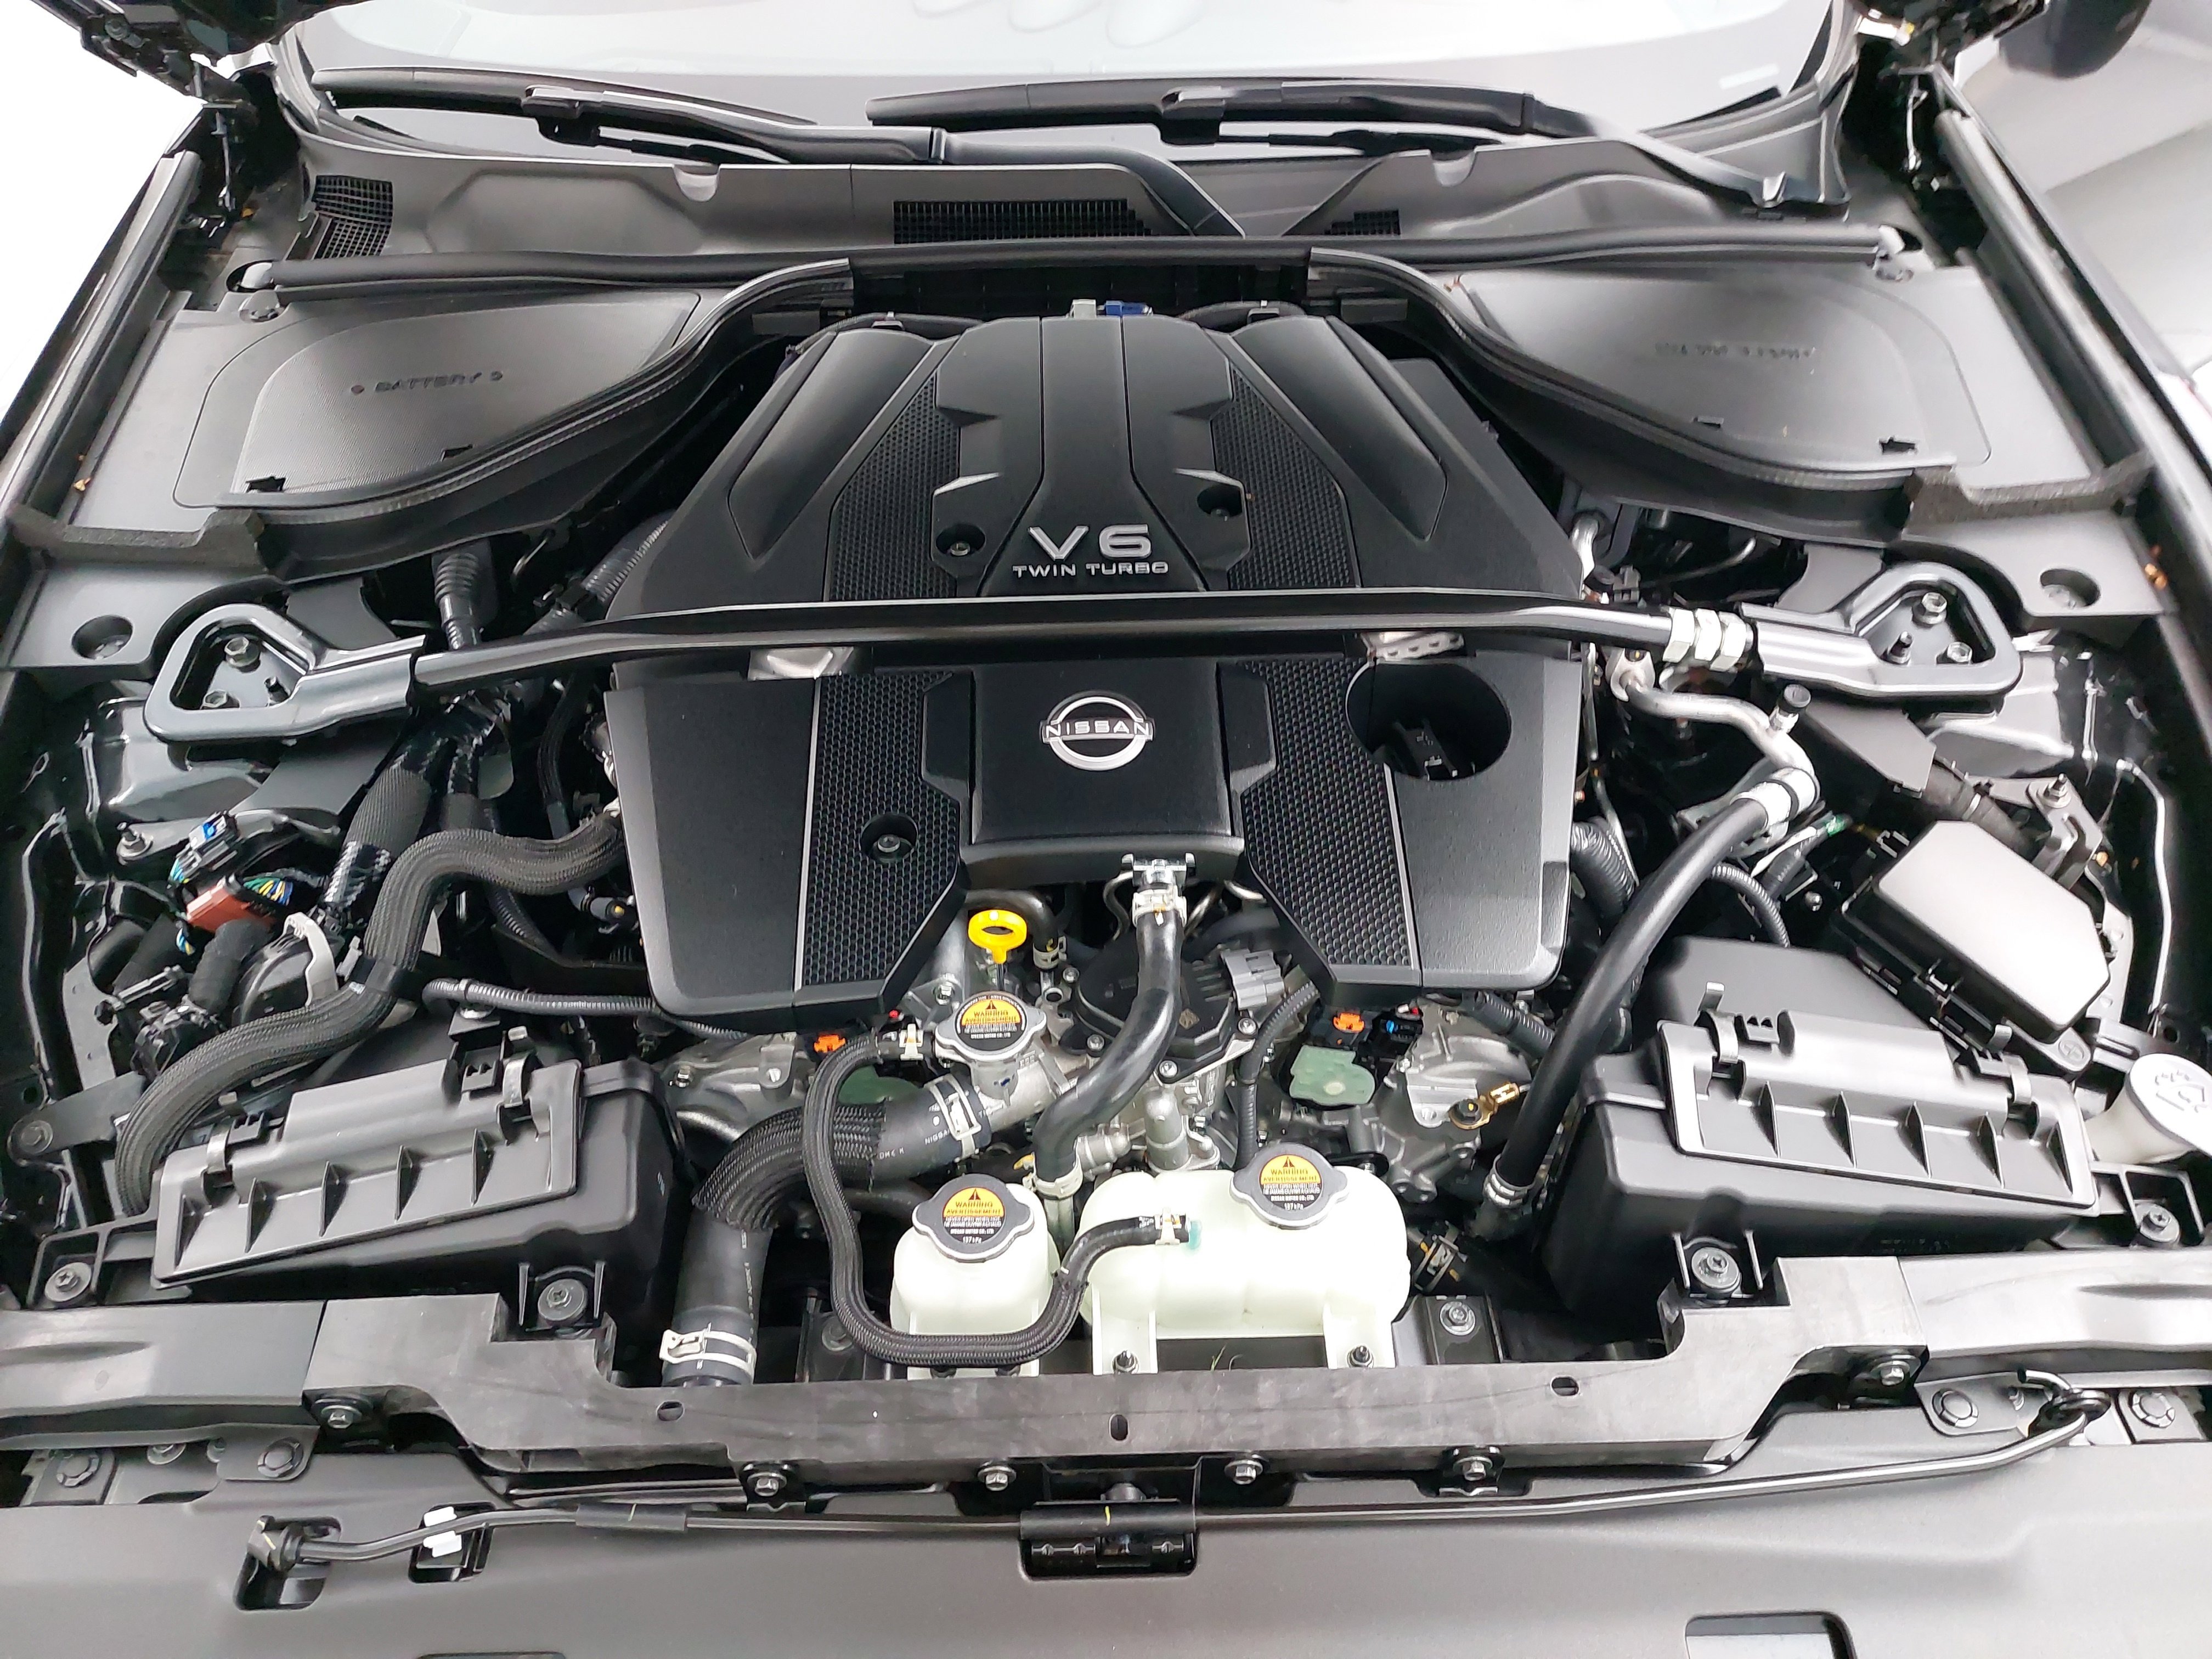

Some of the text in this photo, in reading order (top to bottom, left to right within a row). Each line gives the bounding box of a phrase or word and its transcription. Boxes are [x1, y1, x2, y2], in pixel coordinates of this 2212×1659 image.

[374, 372, 482, 392] BATTERY
[1028, 524, 1152, 561] V6
[1012, 561, 1169, 578] TWIN TURBO
[1046, 720, 1149, 738] NISSAN
